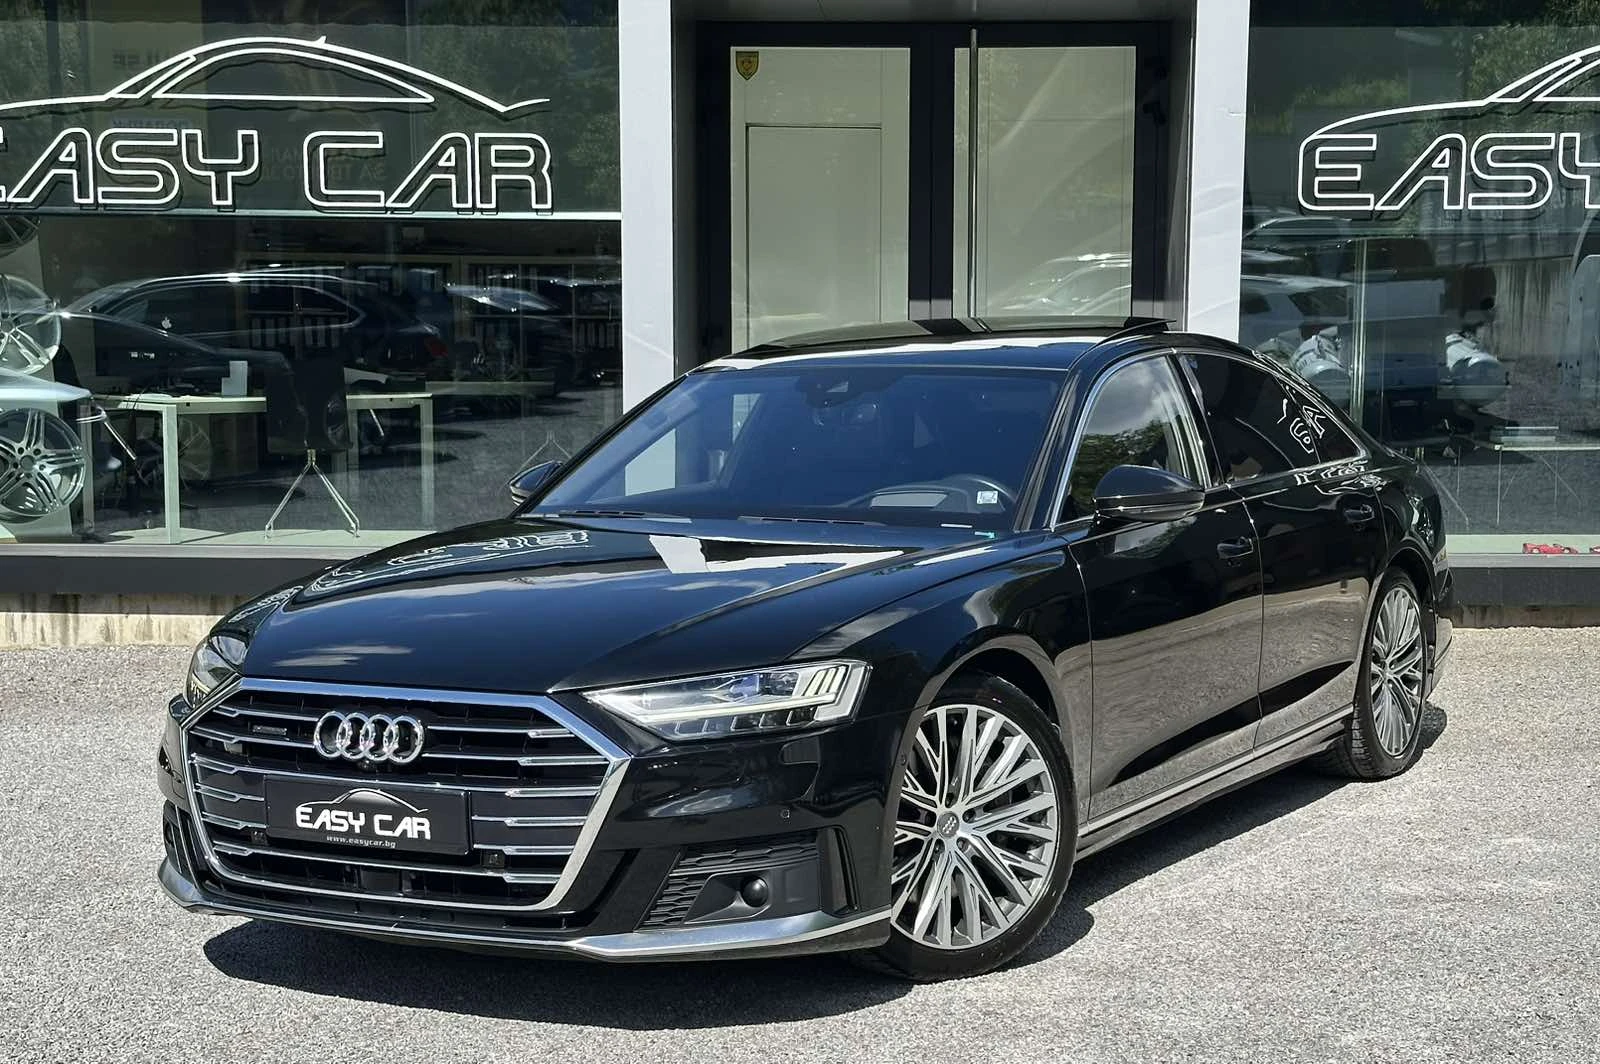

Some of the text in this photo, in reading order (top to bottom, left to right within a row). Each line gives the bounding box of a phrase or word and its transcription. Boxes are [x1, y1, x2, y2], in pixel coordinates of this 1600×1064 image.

[0, 126, 259, 206] ASY
[303, 130, 552, 210] CAR
[295, 806, 431, 840] EASY CAR
[326, 835, 397, 849] www.easycar.bg
